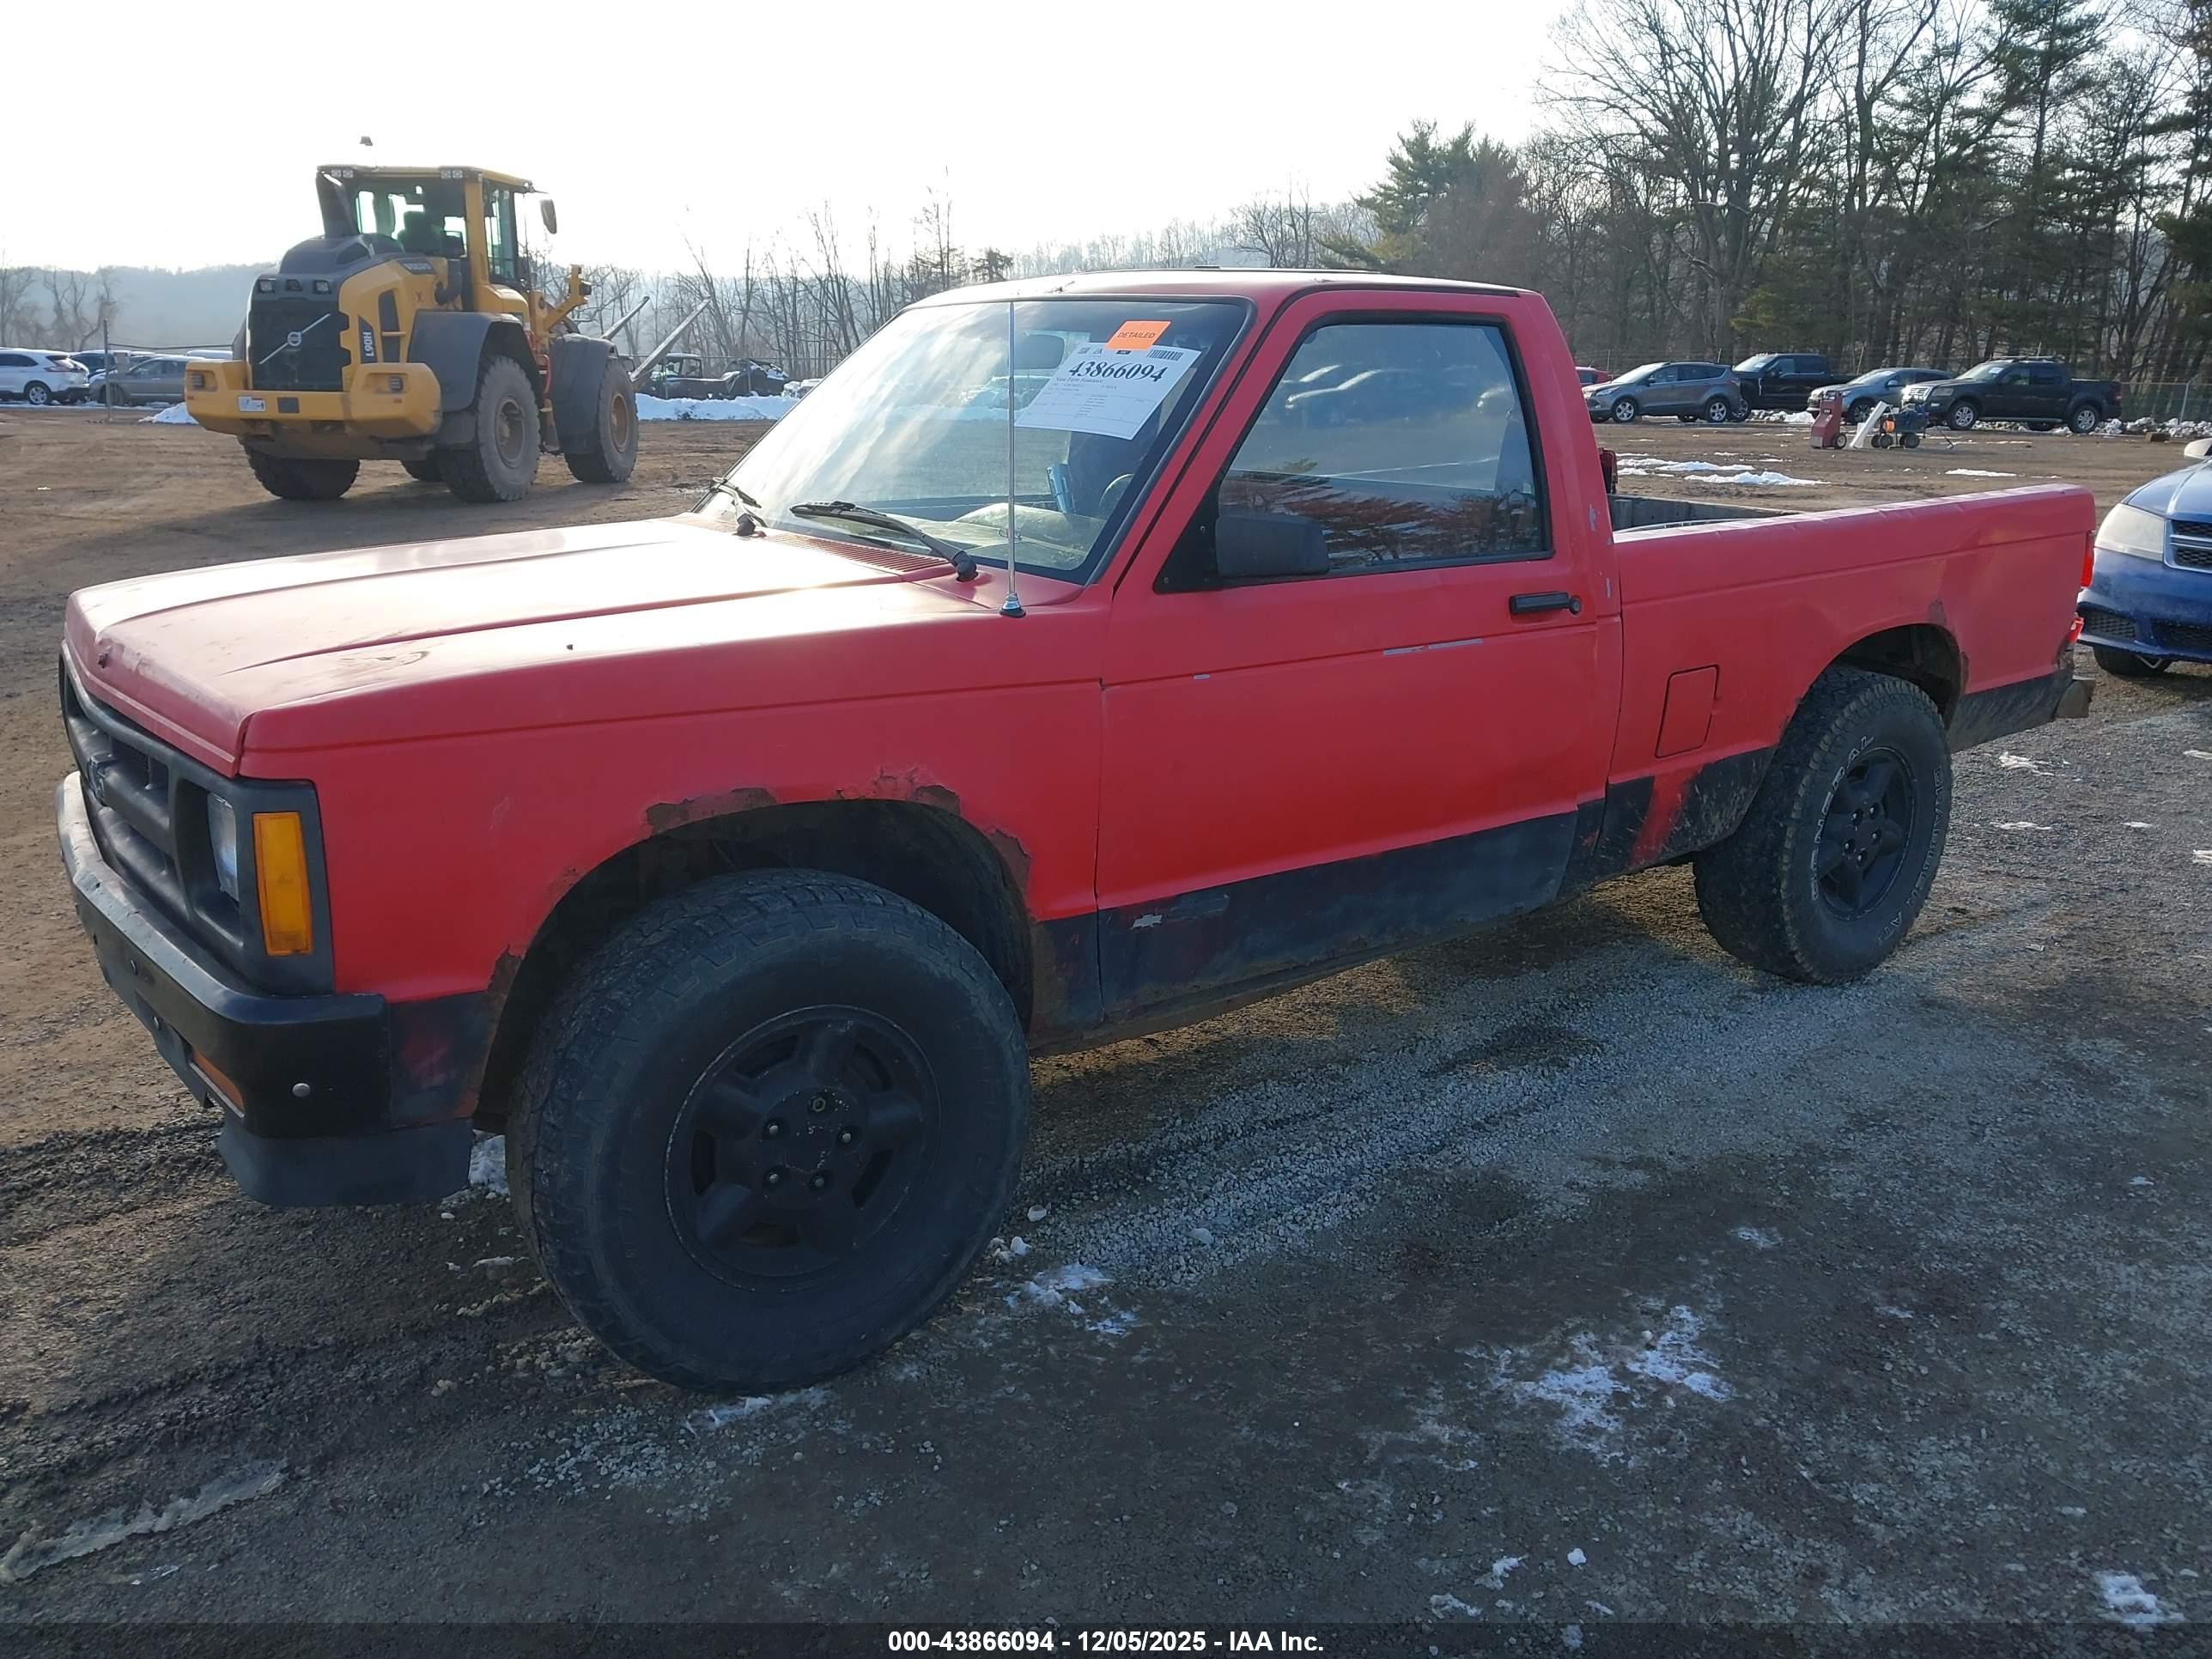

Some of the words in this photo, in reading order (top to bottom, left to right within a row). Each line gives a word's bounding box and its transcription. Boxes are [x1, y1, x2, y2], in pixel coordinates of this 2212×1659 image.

[362, 331, 374, 357] L90H
[1068, 361, 1168, 382] 43866094
[1810, 734, 1875, 901] GENERAL
